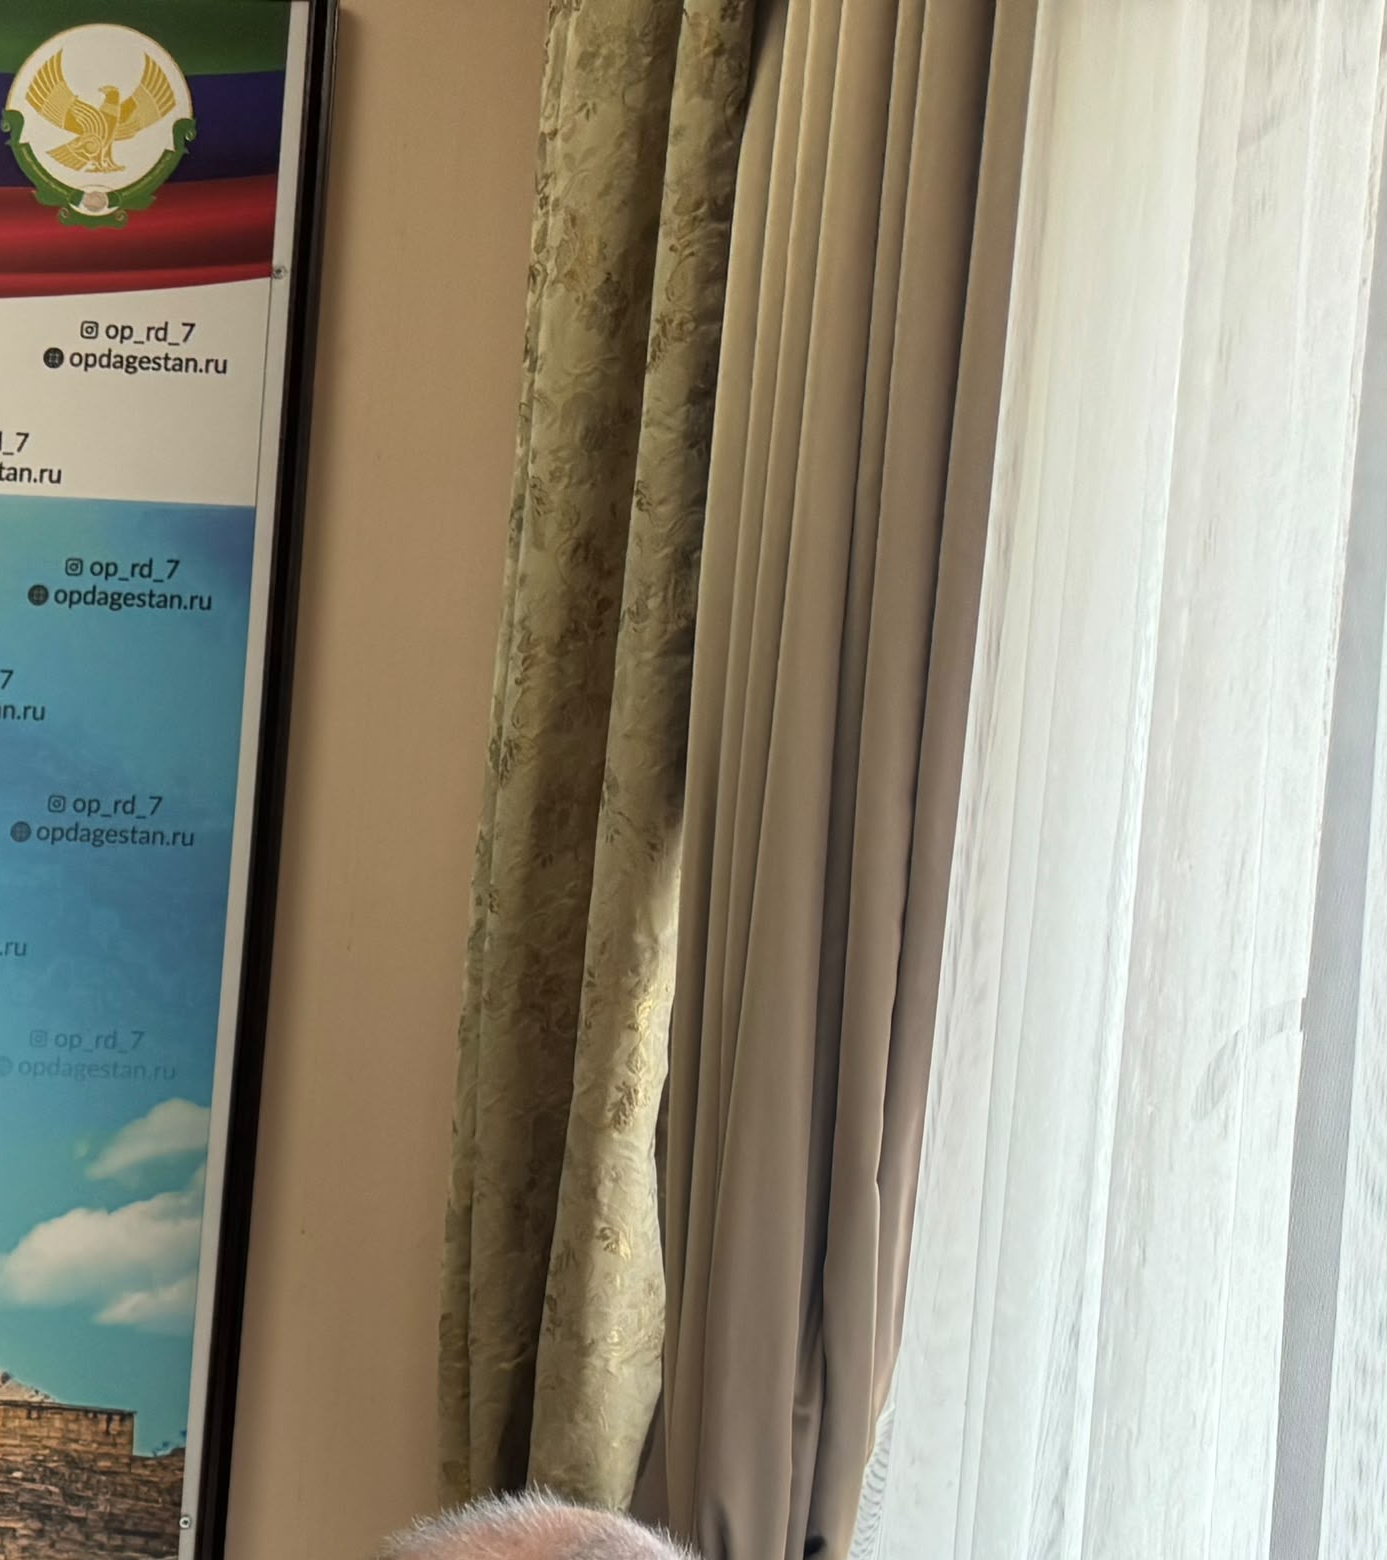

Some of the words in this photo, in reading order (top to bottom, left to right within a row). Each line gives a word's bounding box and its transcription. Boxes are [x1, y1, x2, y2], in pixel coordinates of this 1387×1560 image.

[105, 321, 195, 346] op_rd_7
[69, 348, 227, 374] opdagestan.ru
[90, 558, 180, 583] op_rd_7
[54, 585, 211, 611] opdagestan.ru
[73, 795, 163, 819] op_rd_7
[36, 822, 194, 847] opdagestan.ru
